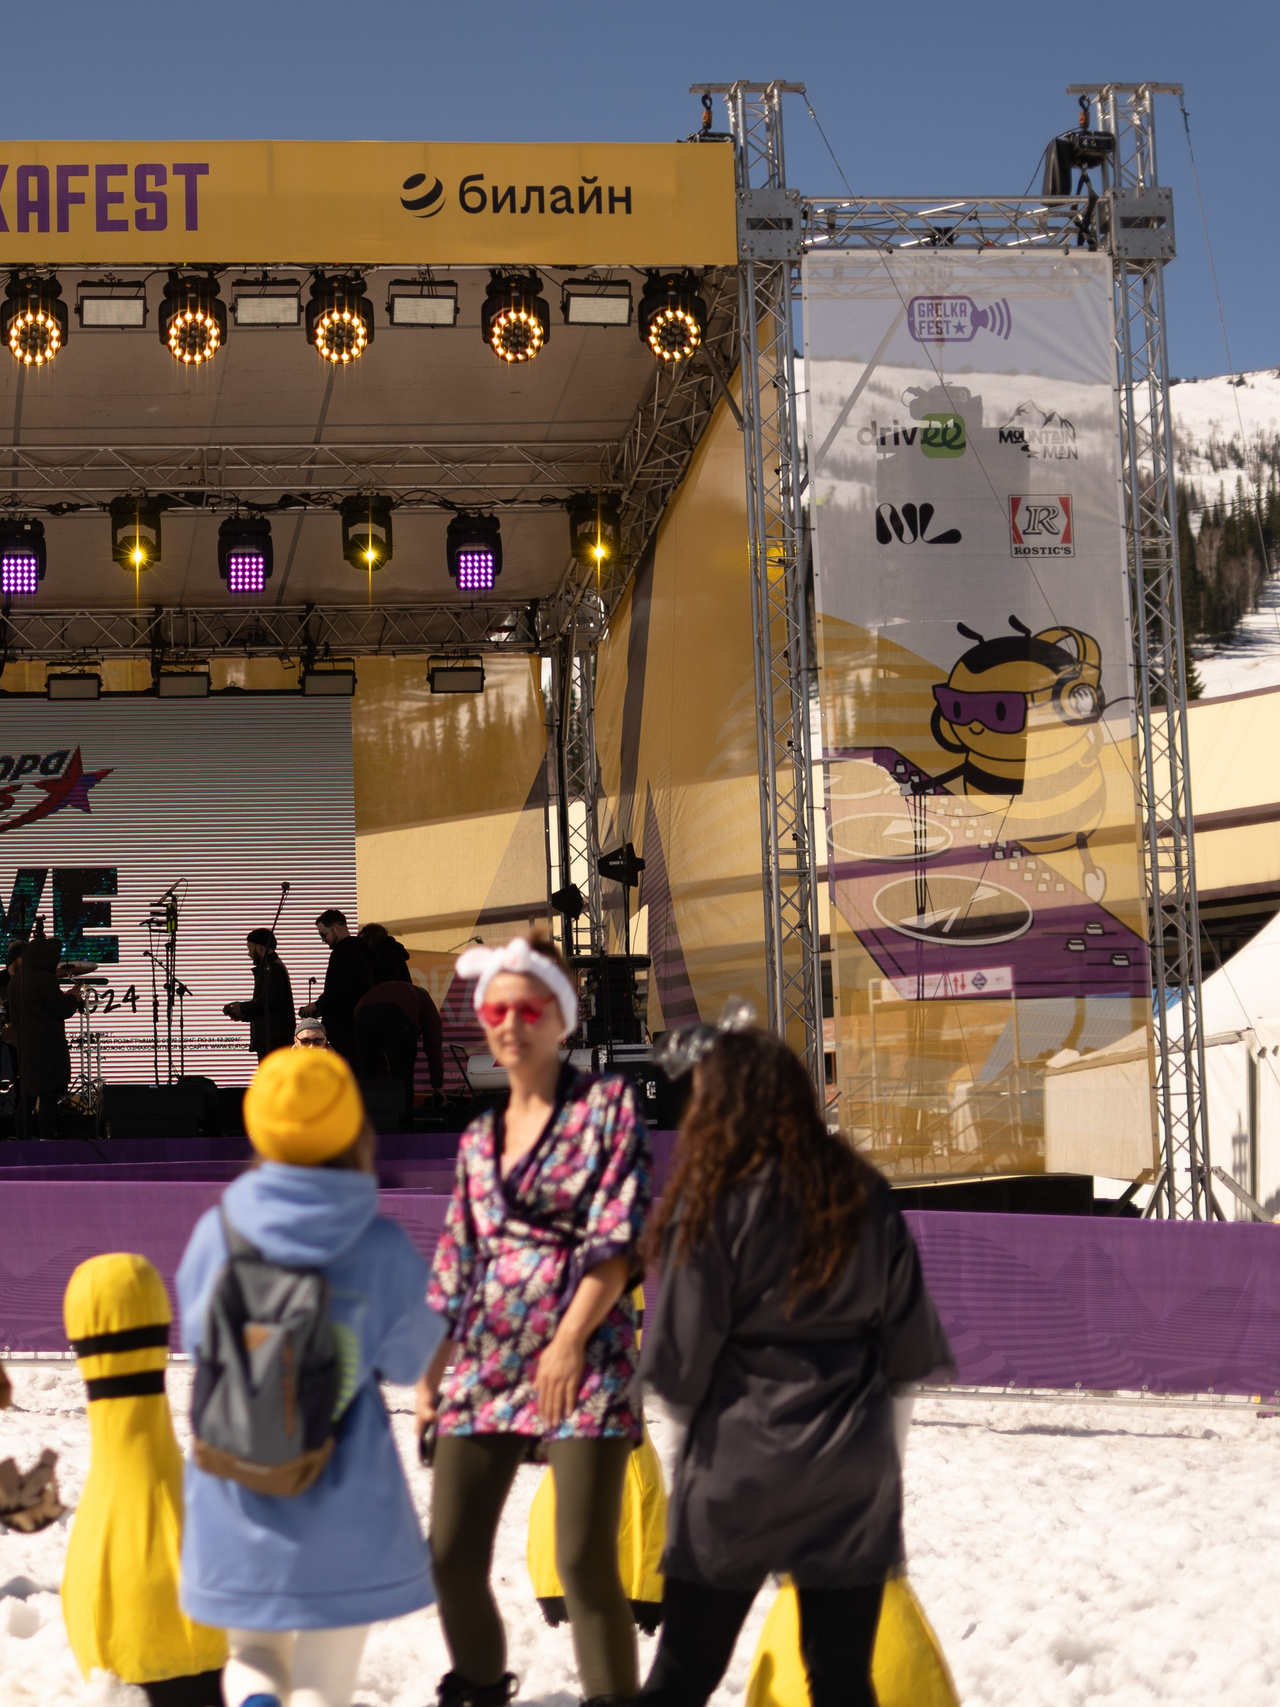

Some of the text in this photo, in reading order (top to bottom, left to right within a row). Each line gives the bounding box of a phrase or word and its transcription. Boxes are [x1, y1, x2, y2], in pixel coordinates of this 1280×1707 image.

[458, 173, 632, 214] билайн
[917, 302, 968, 318] GRELKA
[918, 320, 952, 336] FEST
[1022, 505, 1061, 536] R
[1013, 546, 1072, 556] ROSTIC'S
